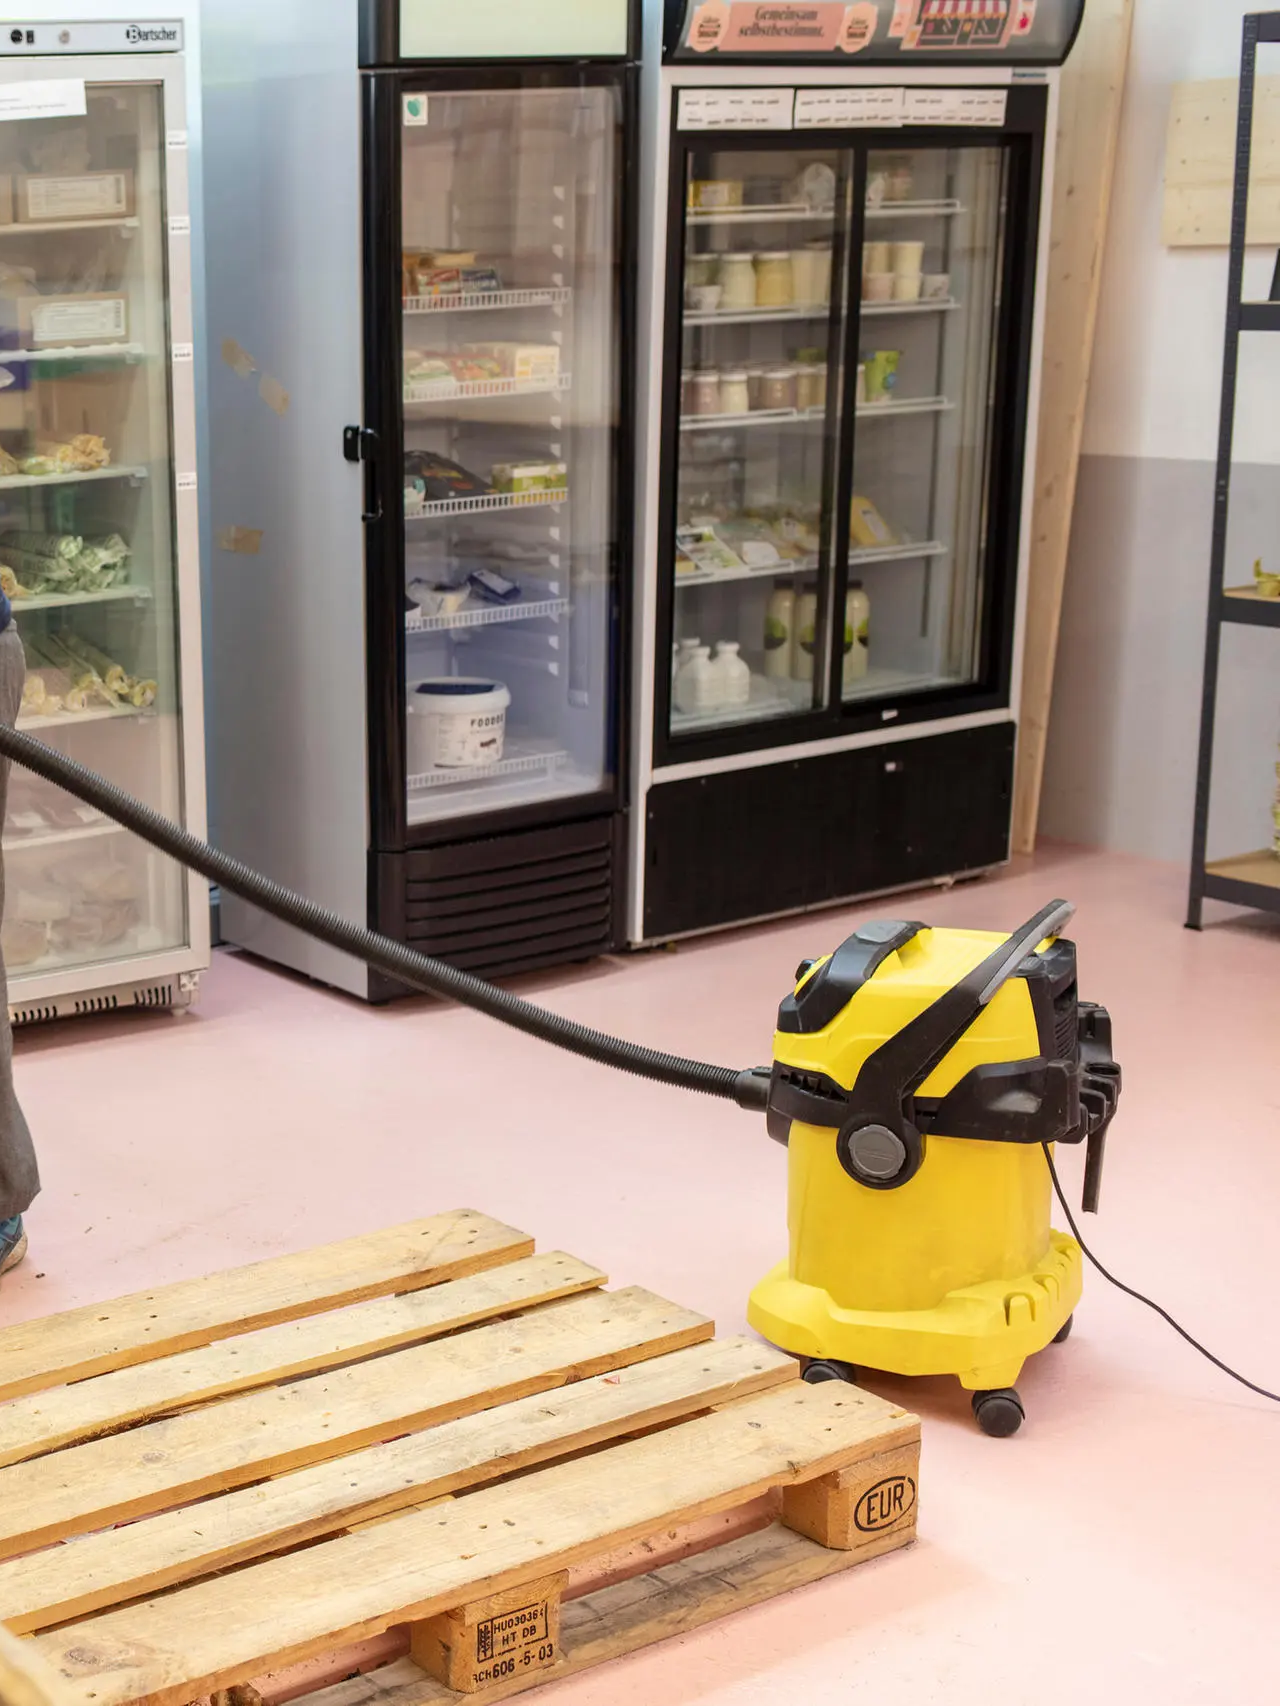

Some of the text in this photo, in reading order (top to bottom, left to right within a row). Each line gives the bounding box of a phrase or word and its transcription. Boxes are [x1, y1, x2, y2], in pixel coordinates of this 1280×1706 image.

[754, 6, 818, 21] Gemeinsam
[867, 1482, 904, 1525] EUR
[502, 1624, 537, 1646] HT DB
